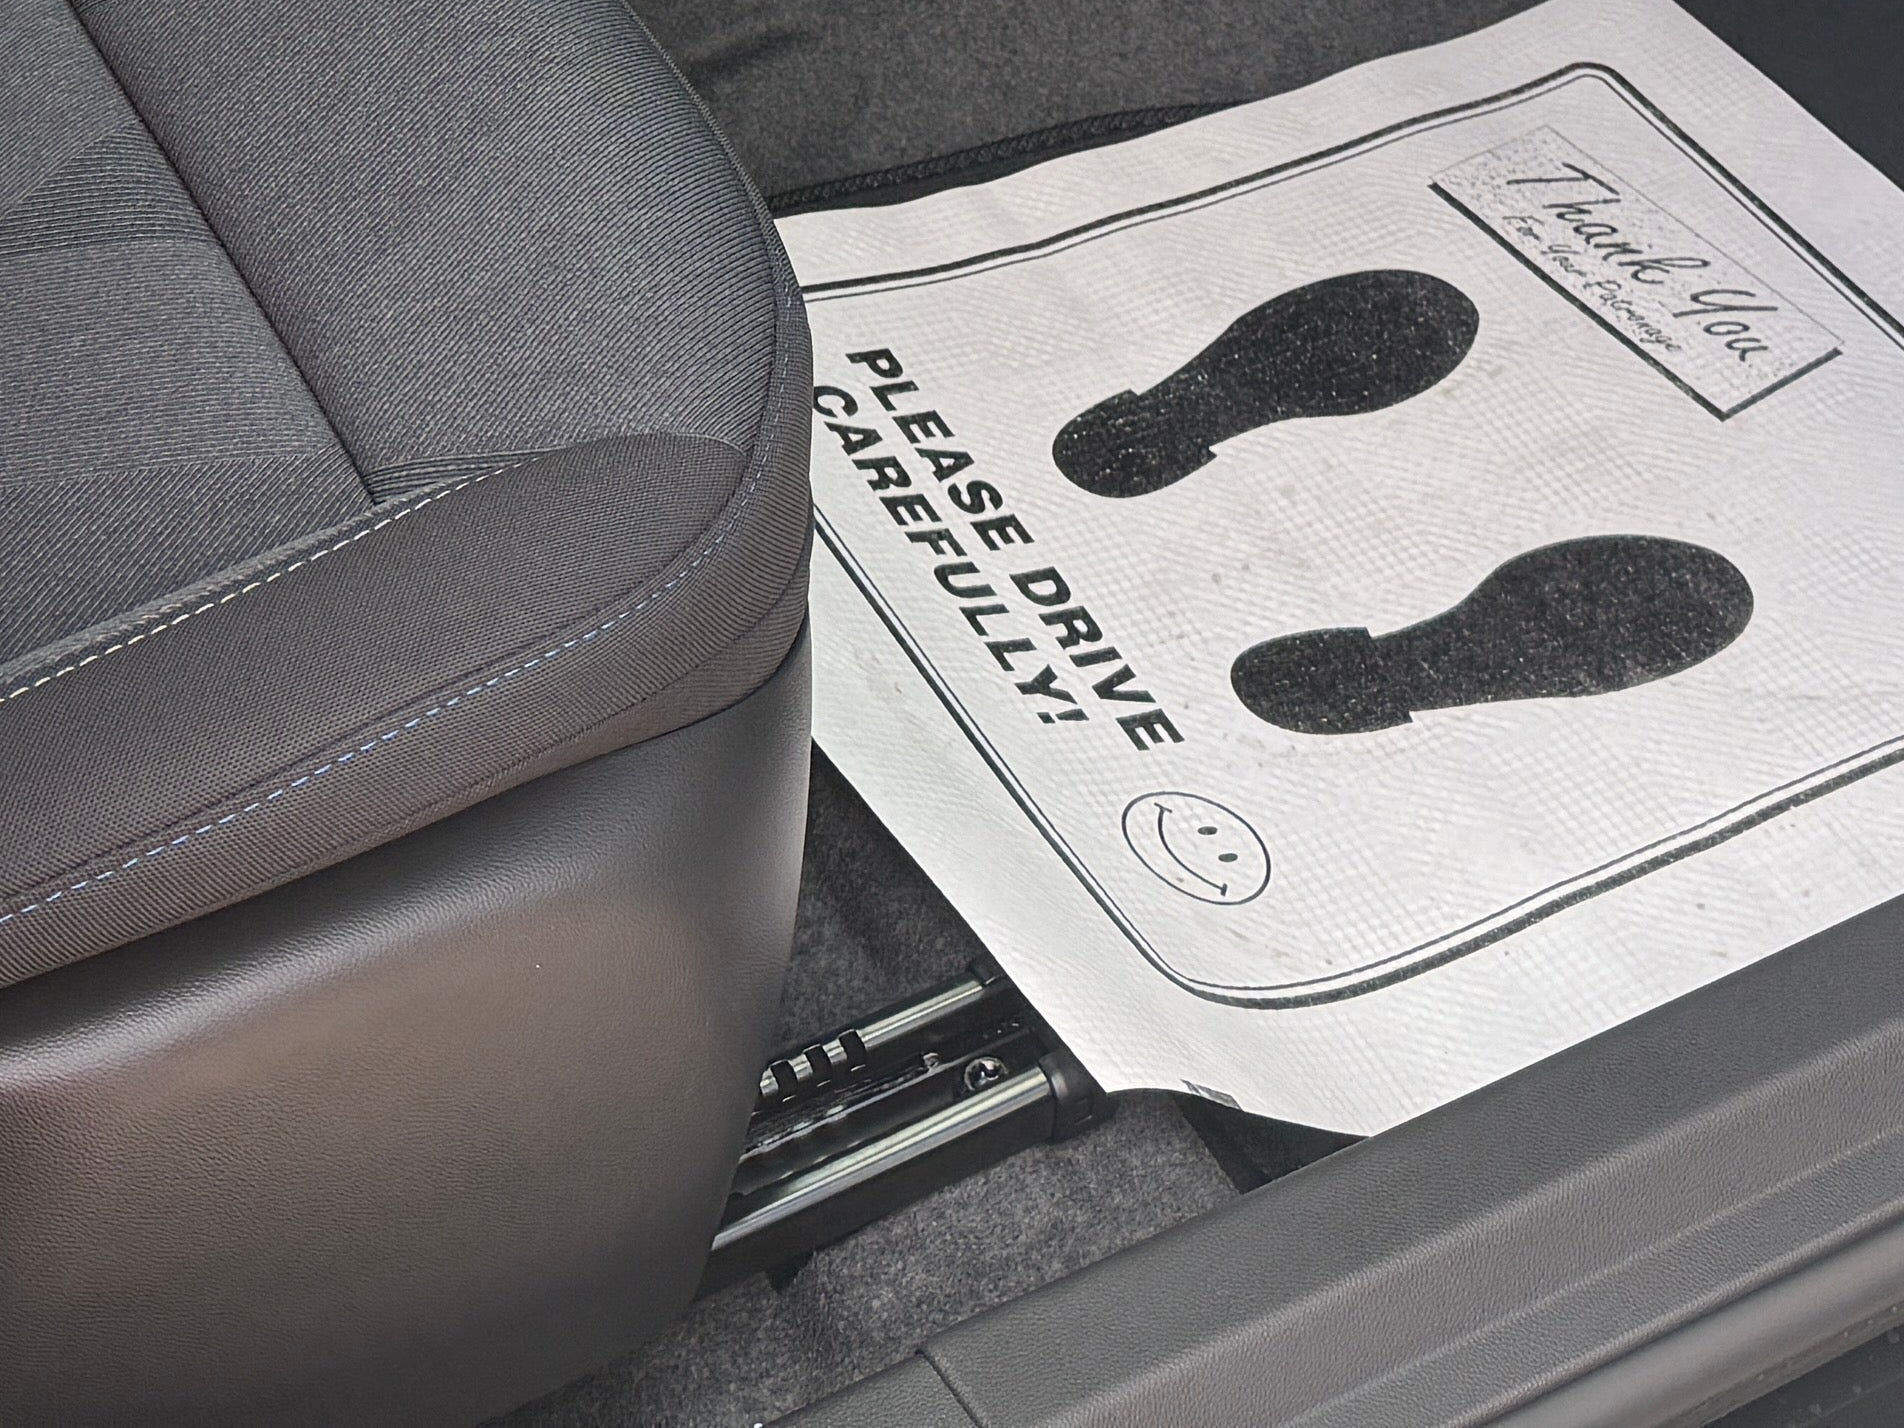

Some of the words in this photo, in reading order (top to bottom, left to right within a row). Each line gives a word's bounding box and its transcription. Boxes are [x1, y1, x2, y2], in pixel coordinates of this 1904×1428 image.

[1505, 162, 1712, 285] Thank
[1671, 288, 1779, 363] You
[1582, 278, 1682, 353] Patronage
[812, 385, 1090, 725] CAREFULLY!
[845, 347, 1036, 552] PLEASE
[1008, 565, 1186, 752] DRIVE
